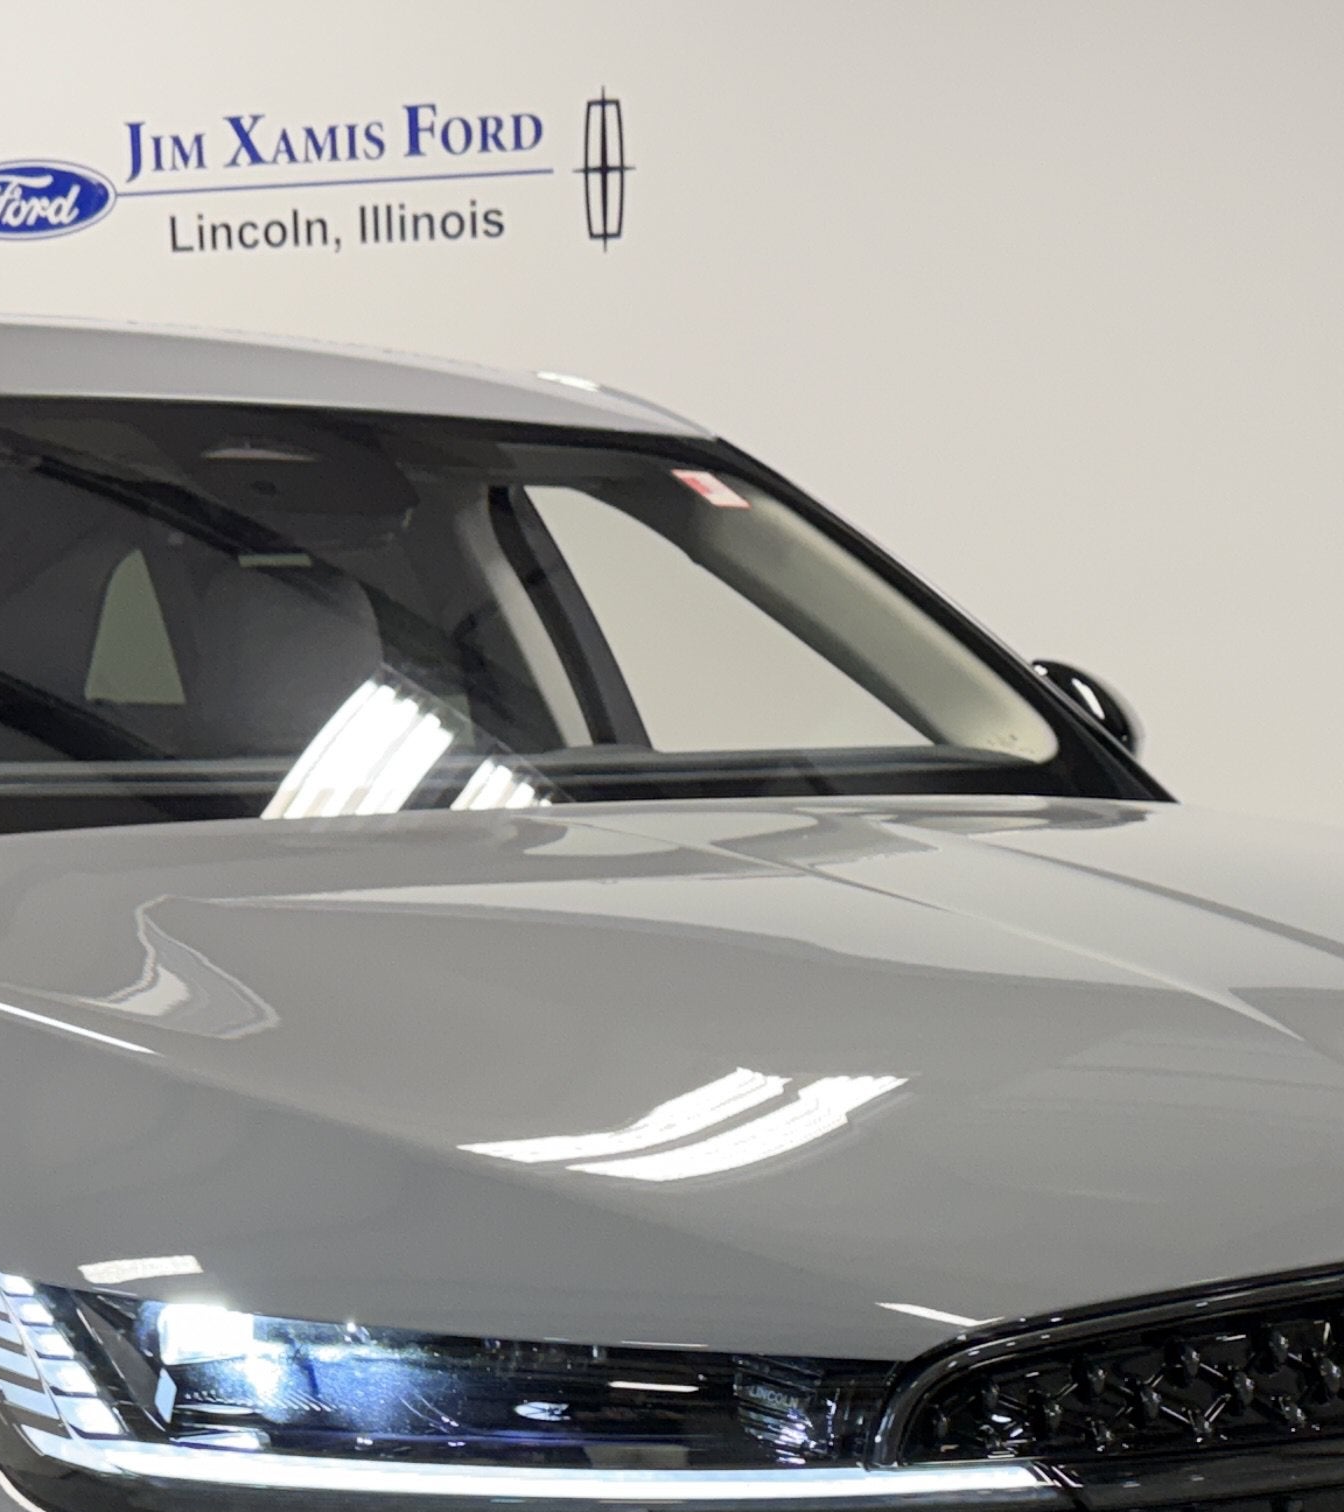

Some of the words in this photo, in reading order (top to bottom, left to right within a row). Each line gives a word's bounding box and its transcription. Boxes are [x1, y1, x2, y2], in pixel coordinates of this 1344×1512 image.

[124, 120, 207, 183] JIM
[222, 113, 386, 168] XAMIS
[402, 102, 544, 159] FORD
[169, 208, 342, 253] Lincoln,
[358, 199, 506, 245] Illinois
